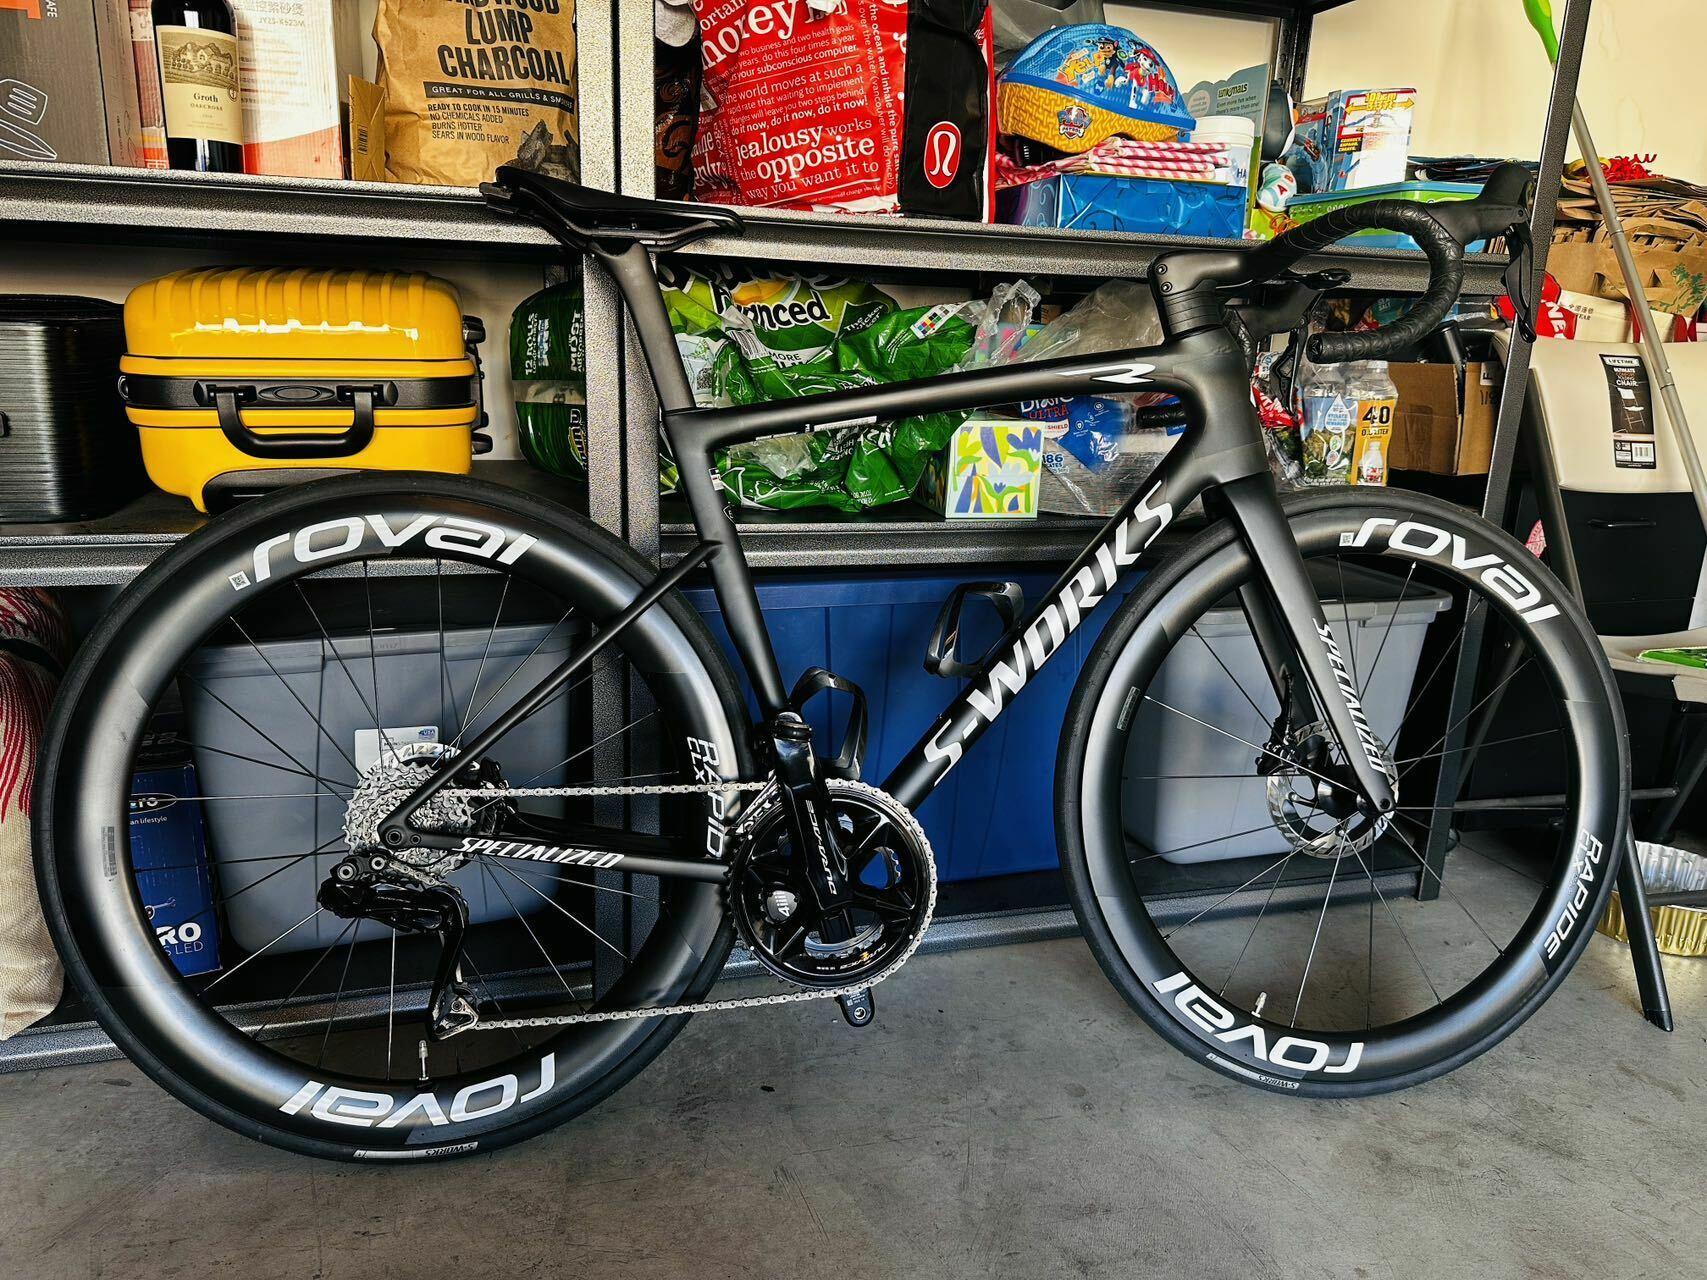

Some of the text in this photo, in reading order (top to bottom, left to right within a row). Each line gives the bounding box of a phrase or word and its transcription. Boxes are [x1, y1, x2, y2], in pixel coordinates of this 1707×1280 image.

[465, 8, 533, 45] LUMP
[869, 3, 878, 21] the
[750, 40, 781, 54] business
[782, 36, 796, 47] and
[797, 32, 811, 43] two
[812, 27, 836, 40] health
[836, 23, 855, 37] goals
[762, 53, 773, 62] do
[774, 49, 790, 60] this
[790, 44, 806, 57] four
[808, 38, 830, 51] times
[872, 23, 884, 54] ocean
[437, 45, 570, 86] CHARCOAL
[737, 43, 859, 79] your subconscious computer.
[878, 56, 889, 75] and
[193, 92, 218, 102] Groth
[432, 85, 463, 95] GREAT
[466, 88, 485, 97] FOR
[508, 92, 540, 101] GRILLS
[542, 94, 548, 102] &
[738, 82, 769, 101] world
[770, 74, 807, 93] moves
[809, 70, 821, 83] at
[824, 64, 852, 80] such
[855, 64, 863, 73] a
[742, 101, 756, 111] rate
[757, 96, 775, 107] that
[776, 90, 805, 103] waiting
[805, 86, 815, 95] to
[816, 75, 865, 93] implement
[859, 9, 896, 189] over the water (vancouver will do nicely)
[881, 78, 894, 109] inhale
[428, 103, 529, 117] READY TO COOK IN 15 MINUTES
[430, 112, 503, 124] NO CHEMICALS ADDED
[729, 112, 751, 126] changes
[751, 109, 764, 120] will
[765, 105, 784, 117] leave
[784, 103, 797, 114] you
[798, 98, 813, 109] two
[813, 93, 836, 107] steps
[730, 95, 868, 136] do it now, do it now, do it now!
[887, 110, 897, 127] the
[432, 122, 483, 131] BURNS HOTTER
[432, 130, 510, 144] SEARS IN WOOD FLAVOR
[735, 118, 872, 166] jealousy works
[889, 128, 899, 151] pure
[741, 134, 875, 183] the opposite
[746, 184, 769, 201] way
[771, 179, 797, 199] you
[800, 166, 842, 188] want
[846, 162, 860, 177] it
[864, 160, 879, 174] to
[526, 312, 535, 356] ROLLS
[570, 310, 581, 372] MOST
[525, 360, 533, 375] 12
[1029, 405, 1069, 419] ULTRA
[1362, 405, 1390, 425] 40
[252, 514, 539, 583] roval
[1351, 517, 1561, 624] roval
[924, 480, 1173, 787] S-WORKS
[1312, 617, 1386, 774] SPECIALIZED
[687, 736, 706, 784] CLX
[140, 815, 168, 825] lifestyle
[452, 837, 625, 869] SPECIALIZED
[805, 799, 838, 895] DURA-ACE
[1572, 828, 1591, 872] CLX
[1544, 834, 1603, 960] RAPIDE
[175, 941, 204, 956] LED
[1151, 971, 1365, 1074] roval
[278, 1052, 555, 1128] roval
[1258, 1074, 1298, 1090] S-WORKS
[425, 1141, 475, 1157] S-WORKS
